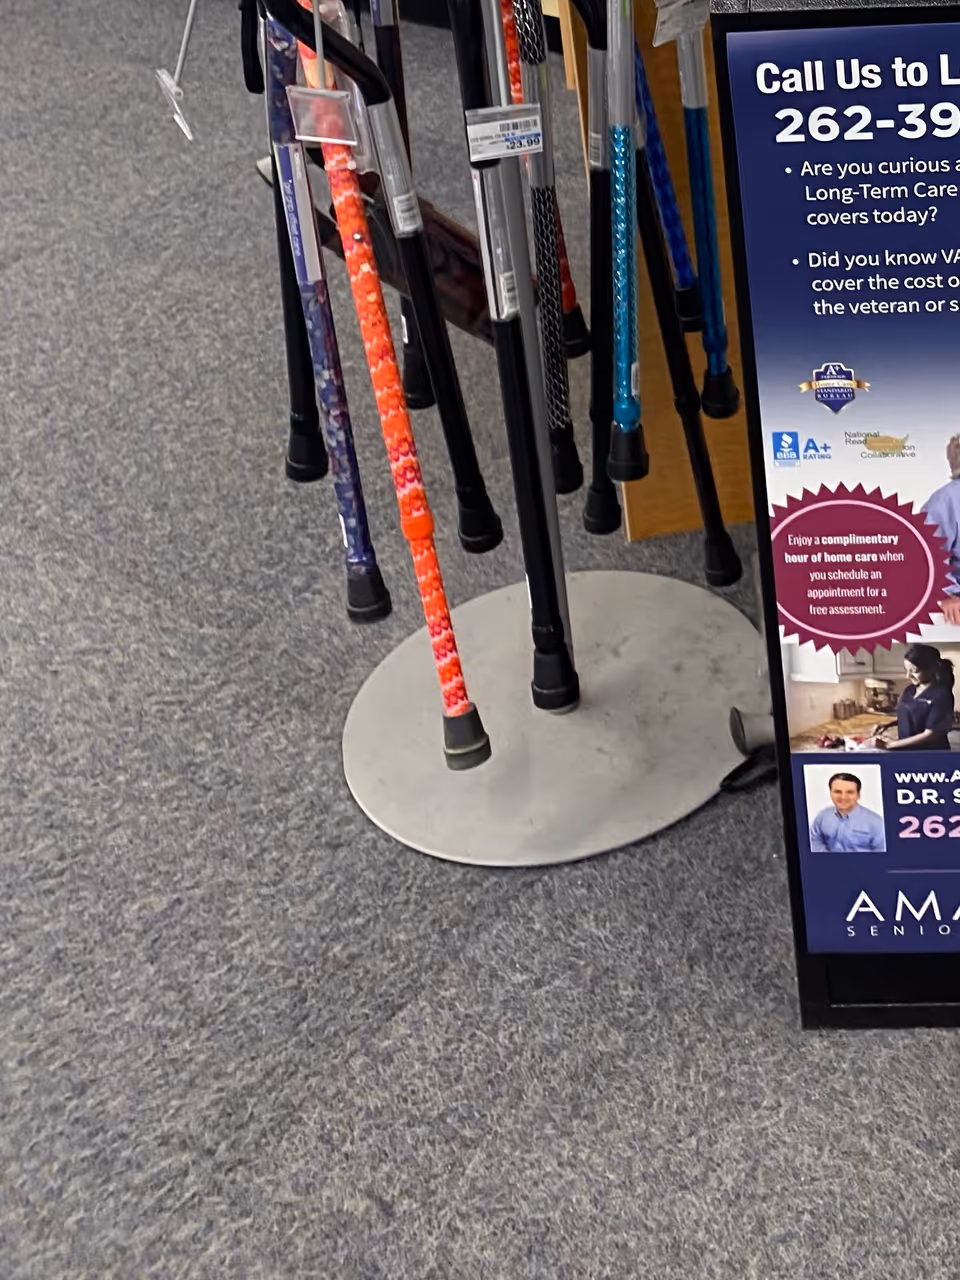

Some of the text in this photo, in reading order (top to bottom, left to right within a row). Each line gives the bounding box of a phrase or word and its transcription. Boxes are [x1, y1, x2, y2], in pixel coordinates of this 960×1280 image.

[756, 60, 825, 94] Call
[835, 58, 882, 90] Us
[891, 56, 929, 87] to
[805, 183, 909, 205] Long-Term
[913, 181, 958, 198] Care
[808, 250, 840, 268] Did
[843, 254, 880, 271] you
[884, 249, 938, 266] know
[804, 438, 831, 453] A+
[788, 534, 898, 546] Enjoy a complimentary
[785, 551, 904, 563] hour of home care when
[809, 604, 886, 615] free assessment.
[897, 788, 945, 806] D.R.
